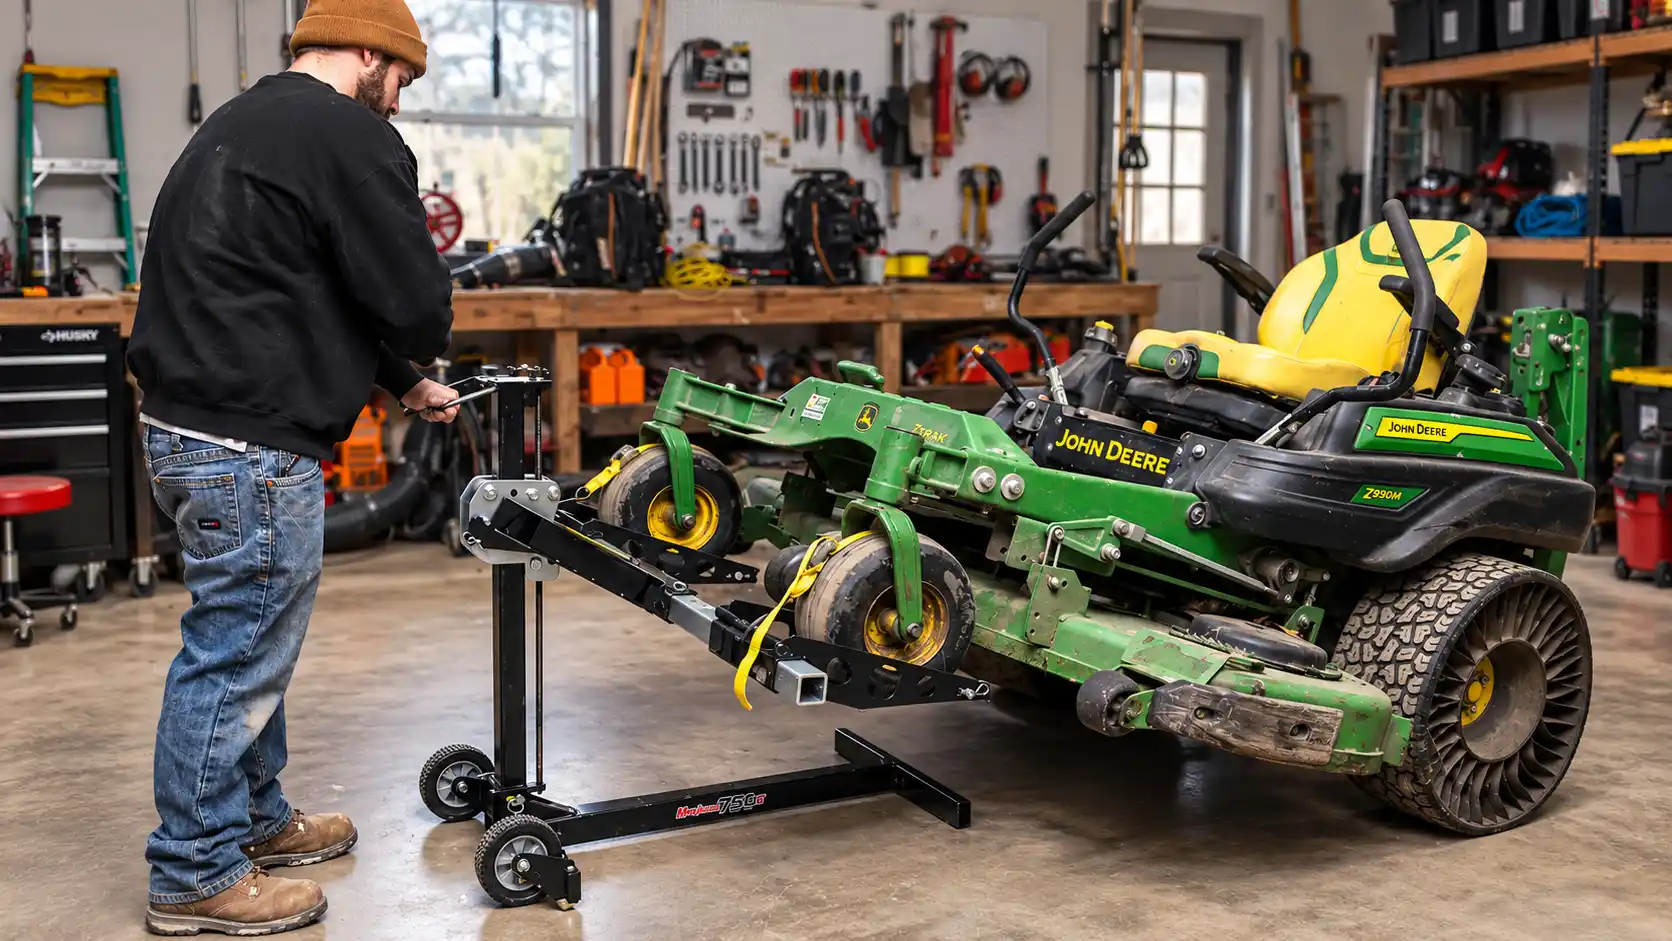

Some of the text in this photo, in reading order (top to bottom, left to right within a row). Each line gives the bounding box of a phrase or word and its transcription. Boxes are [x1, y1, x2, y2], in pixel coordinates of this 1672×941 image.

[56, 329, 100, 341] HUSKY
[1388, 421, 1447, 436] JOHN DEERE
[1055, 429, 1170, 475] JOHN DEERE
[1363, 488, 1402, 500] Z990M
